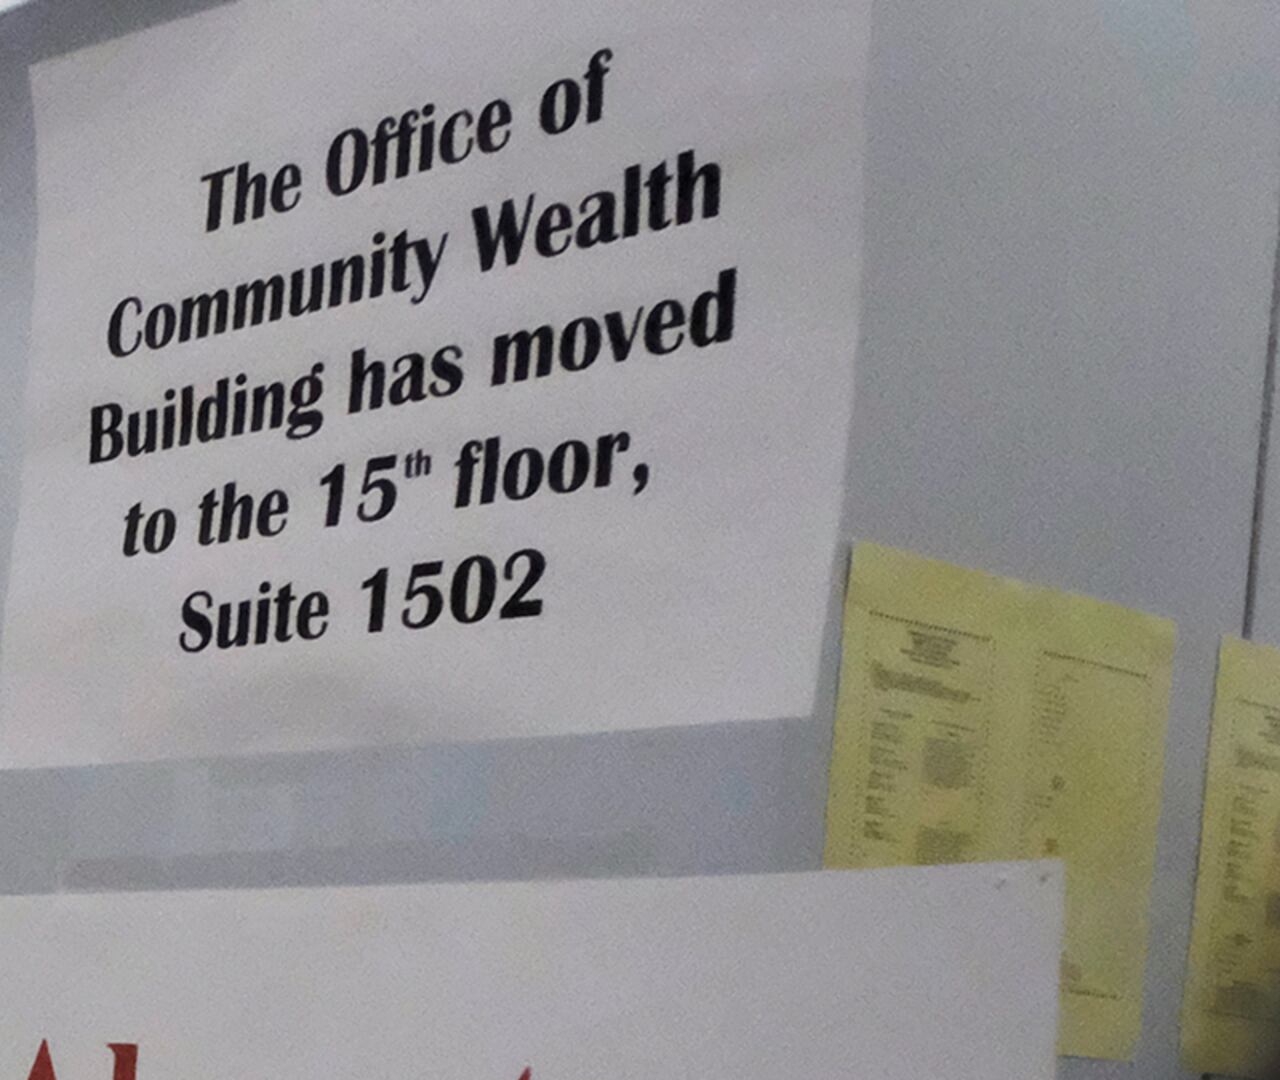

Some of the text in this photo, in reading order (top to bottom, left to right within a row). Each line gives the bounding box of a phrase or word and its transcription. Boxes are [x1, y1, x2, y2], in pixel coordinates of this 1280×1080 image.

[201, 48, 613, 232] The Office of
[107, 149, 721, 358] Community Wealth
[89, 267, 737, 464] Building has moved
[123, 431, 649, 557] to the 15th floor,
[179, 548, 546, 653] Suite 1502
